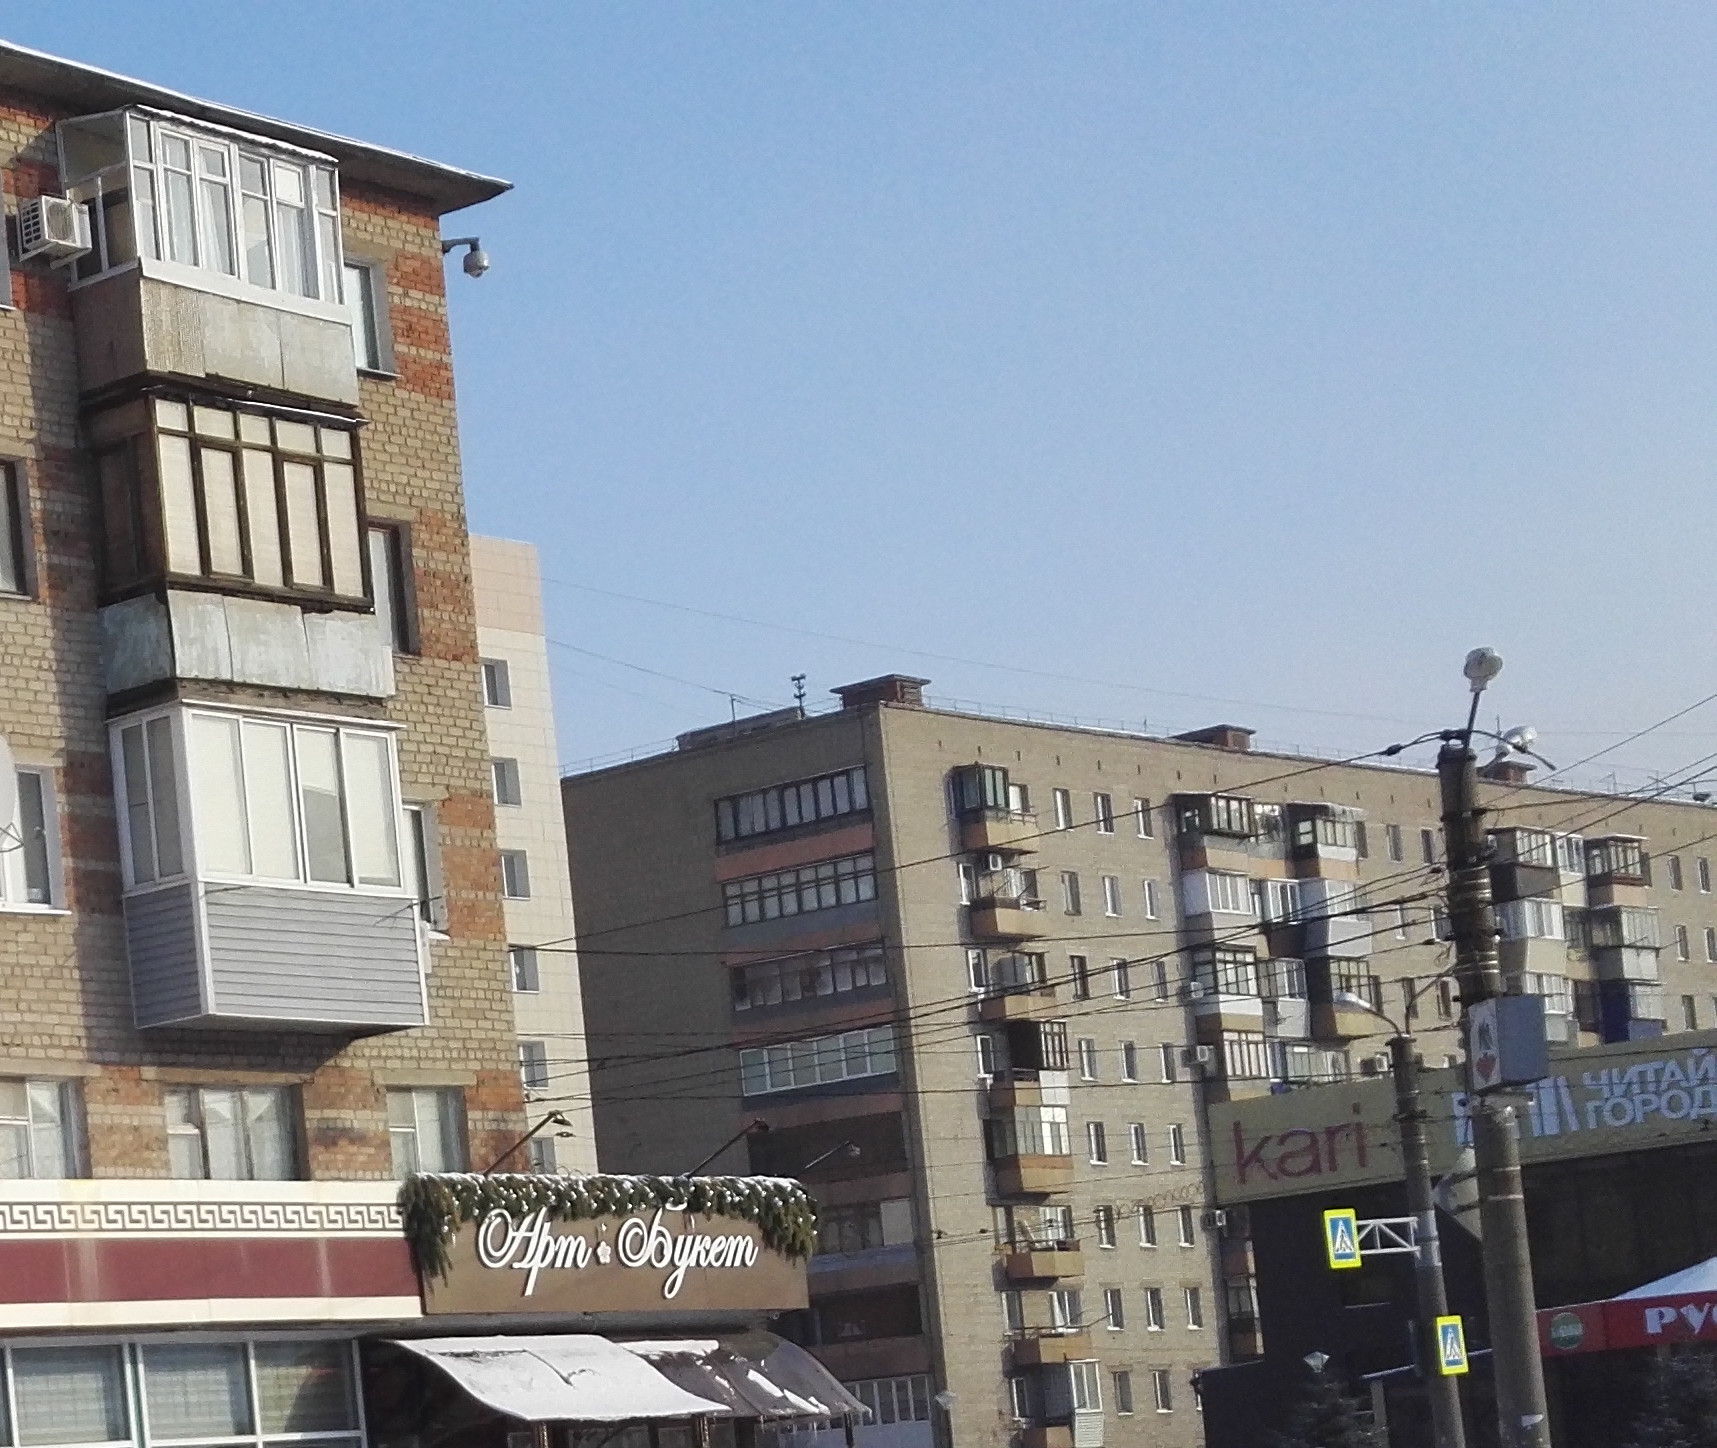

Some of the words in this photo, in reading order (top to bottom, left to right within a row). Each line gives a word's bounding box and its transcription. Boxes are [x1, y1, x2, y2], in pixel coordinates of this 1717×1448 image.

[1583, 1048, 1715, 1099] ЧИТАЙ
[1233, 1102, 1367, 1185] kari
[478, 1207, 593, 1296] Арт
[618, 1202, 759, 1300] Букет
